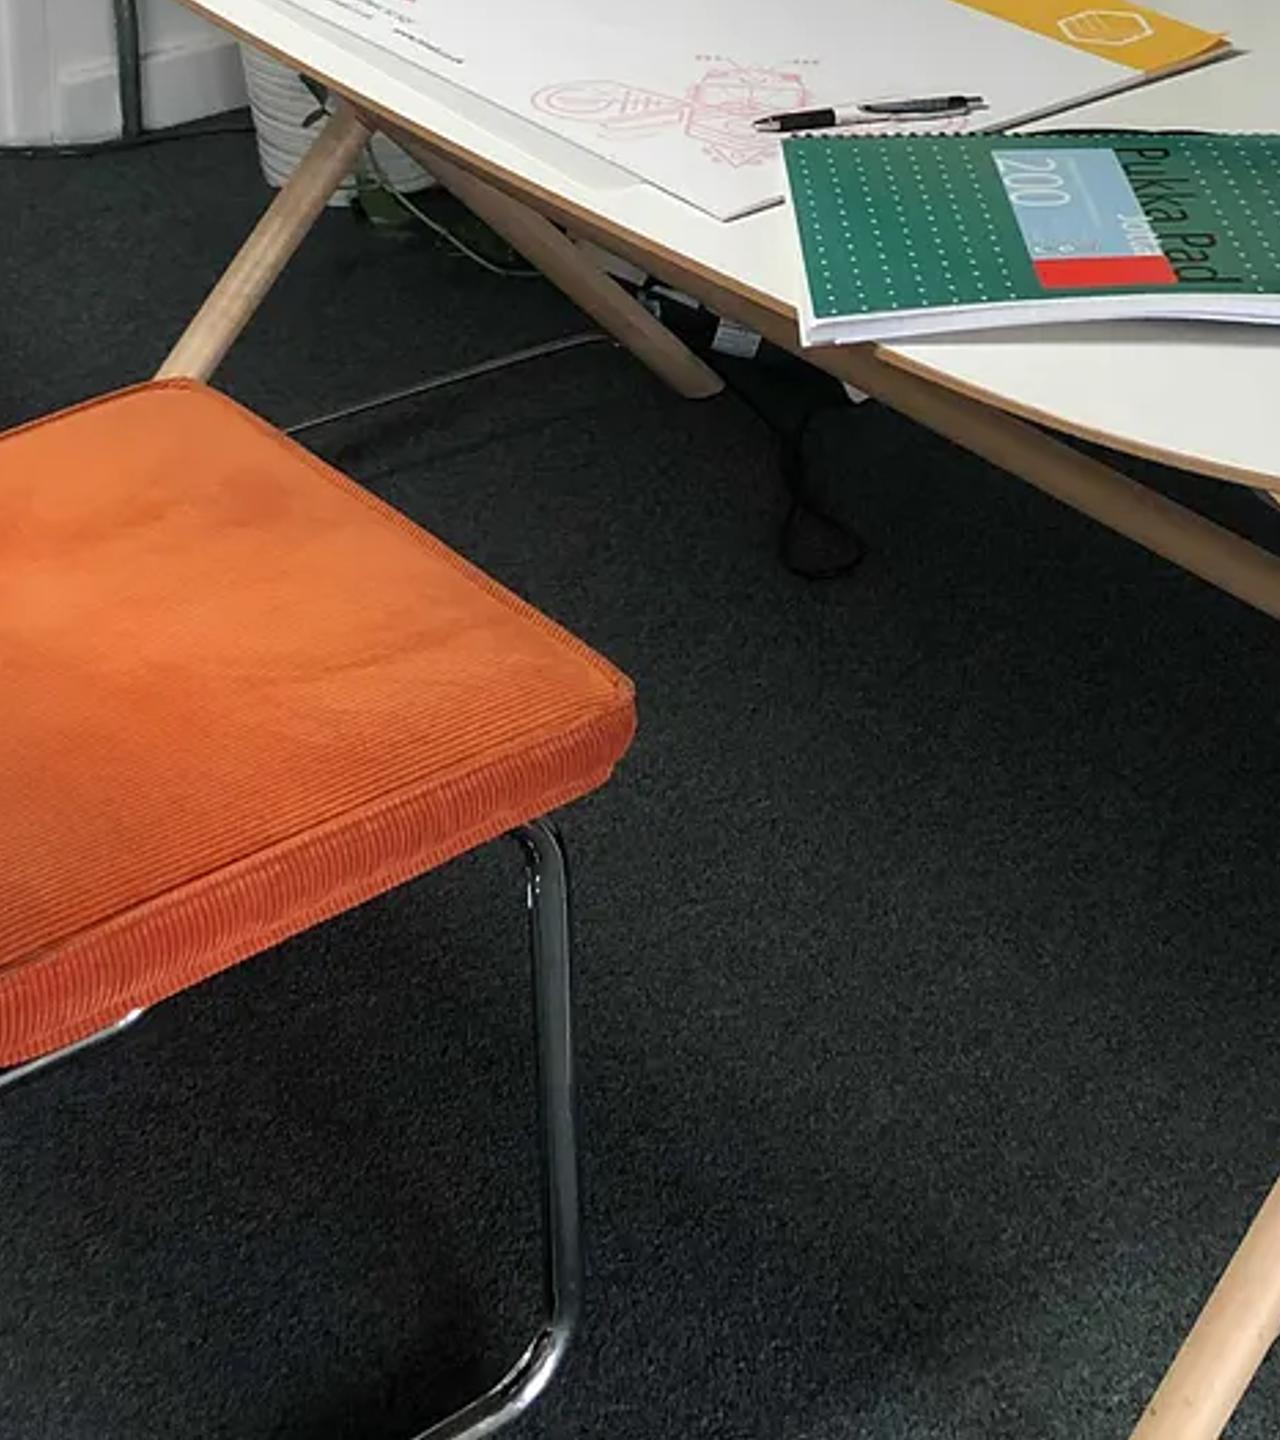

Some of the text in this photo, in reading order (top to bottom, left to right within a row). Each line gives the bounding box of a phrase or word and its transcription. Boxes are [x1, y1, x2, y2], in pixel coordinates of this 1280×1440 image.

[997, 156, 1072, 208] 200
[1115, 147, 1244, 284] Pukka Pad
